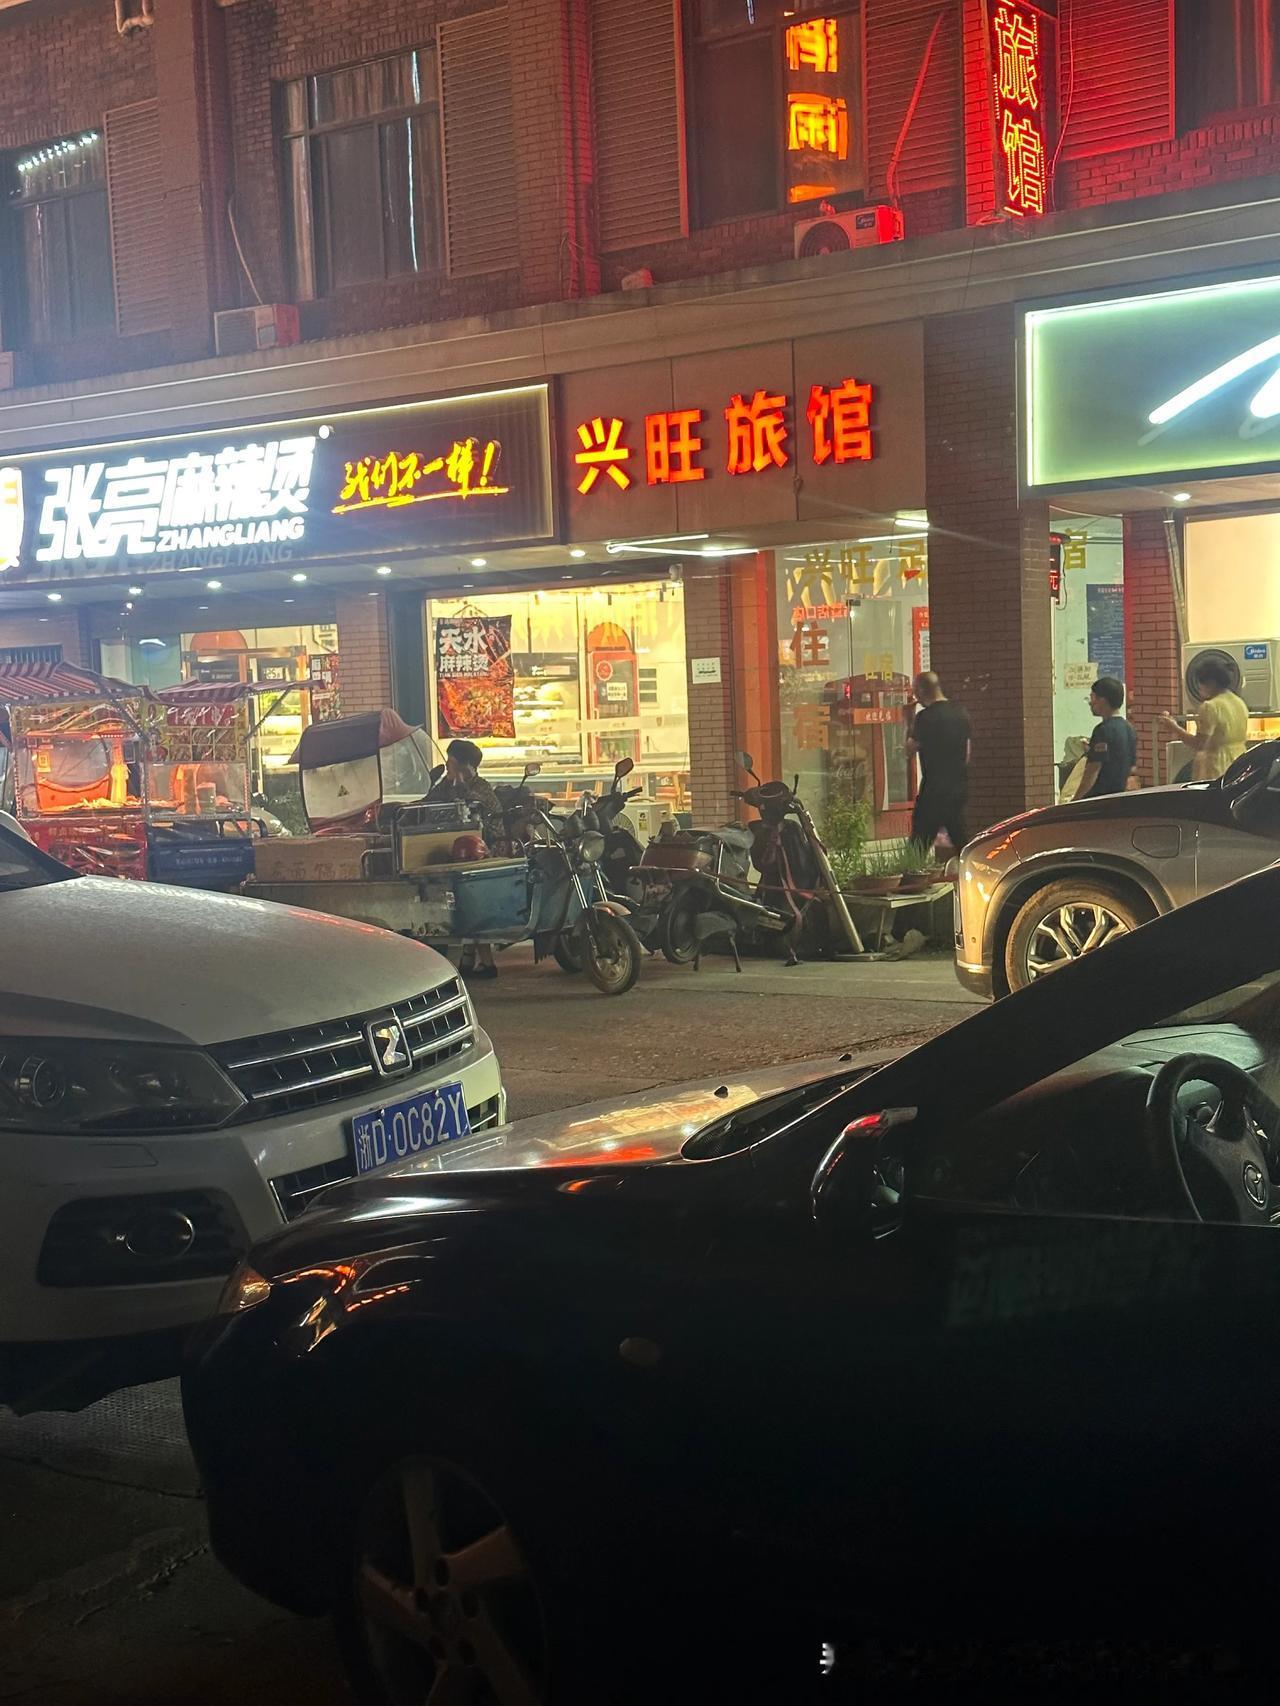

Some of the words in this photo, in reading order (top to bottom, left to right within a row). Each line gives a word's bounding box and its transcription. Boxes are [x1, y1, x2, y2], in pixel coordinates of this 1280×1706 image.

[995, 8, 1043, 213] 旅馆
[574, 377, 873, 495] 兴旺旅馆
[156, 516, 305, 552] ZHANGLIANG
[439, 626, 489, 655] 天水
[439, 655, 489, 672] 麻辣烫
